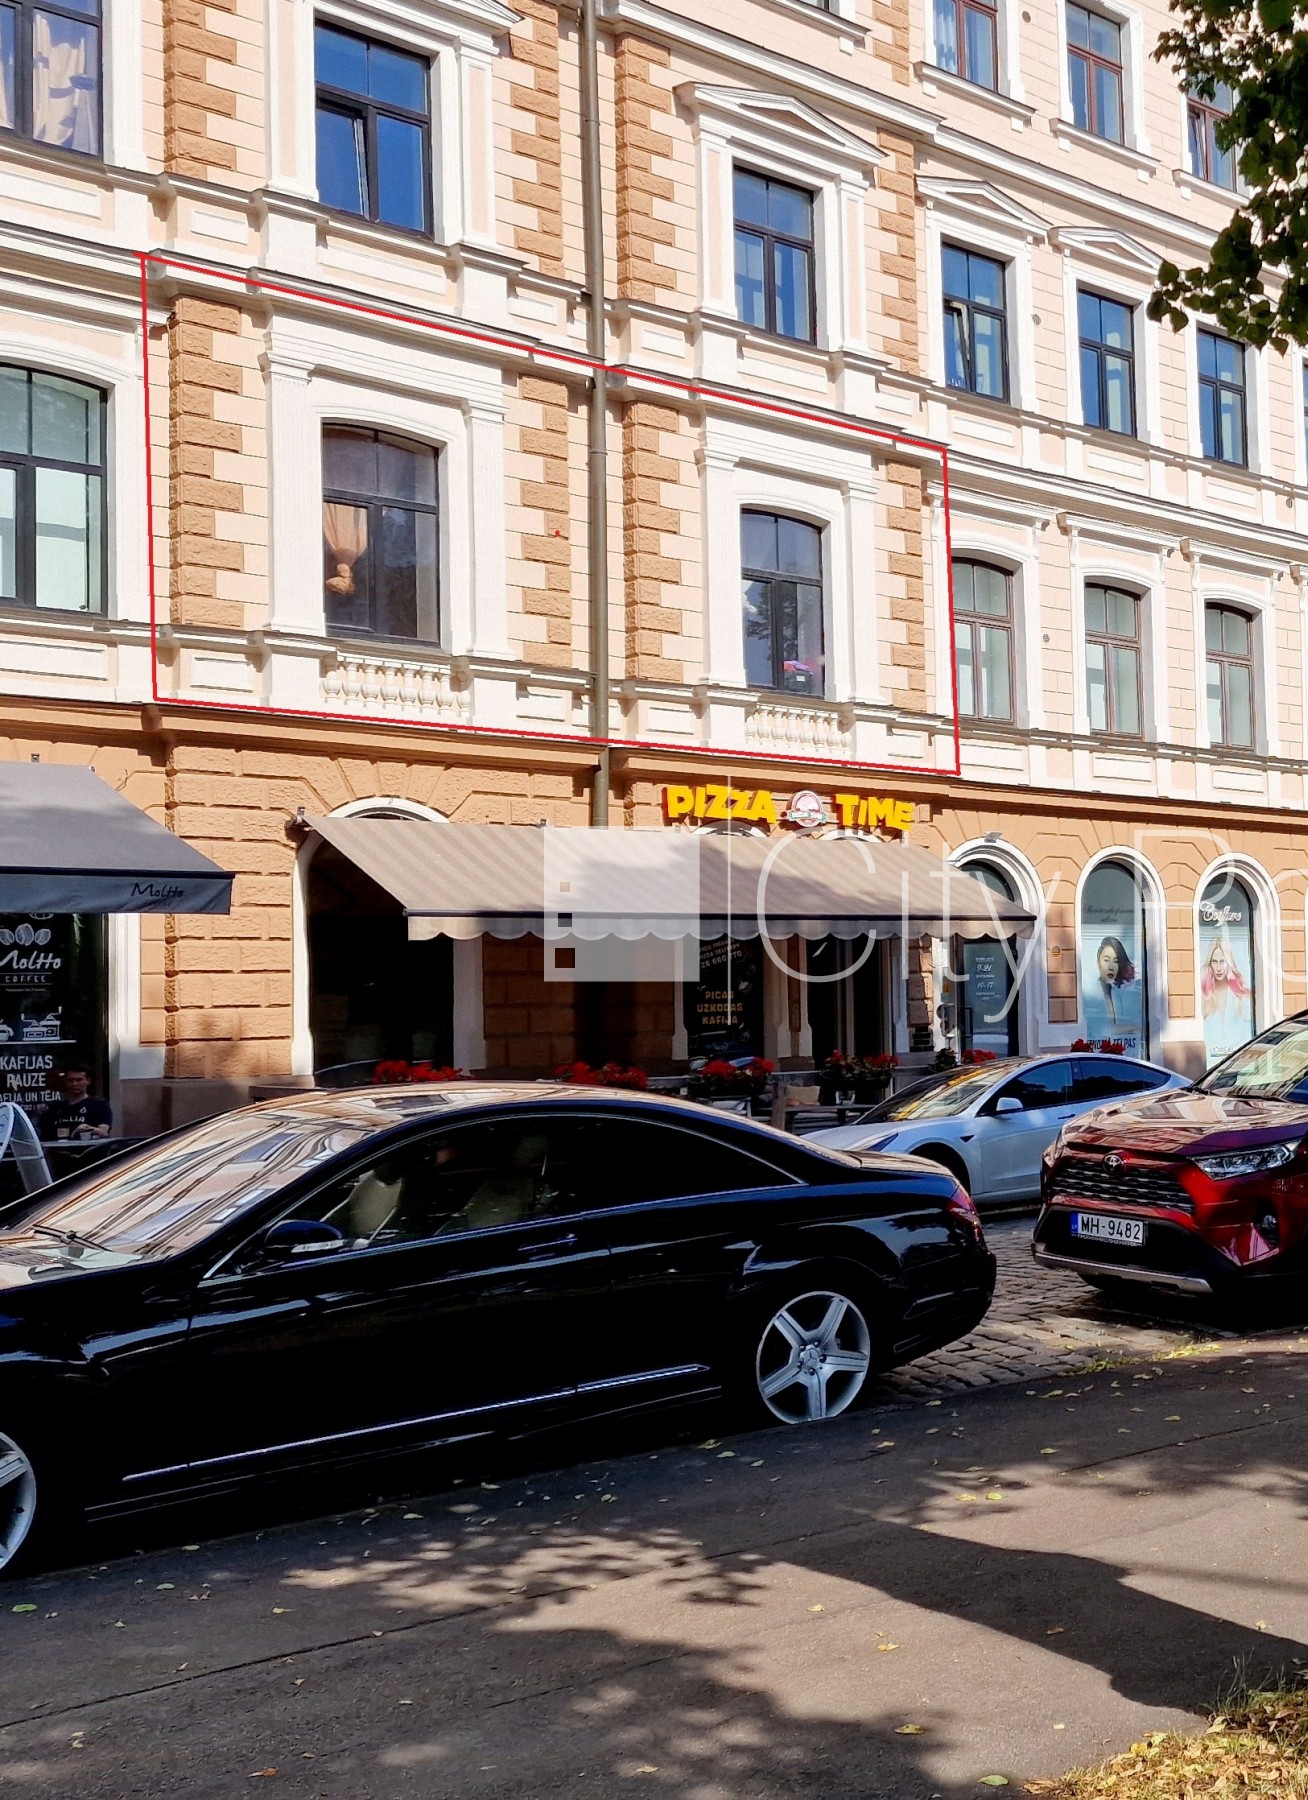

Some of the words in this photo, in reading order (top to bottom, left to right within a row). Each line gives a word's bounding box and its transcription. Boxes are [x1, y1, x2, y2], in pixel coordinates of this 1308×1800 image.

[664, 784, 777, 824] PIZZA
[834, 793, 914, 831] TIME
[5, 975, 47, 983] COFFEE
[0, 1055, 53, 1070] KAFIJAS
[6, 1072, 47, 1088] PAUZE
[25, 1092, 38, 1102] UN
[1081, 1215, 1141, 1240] MH-9482
